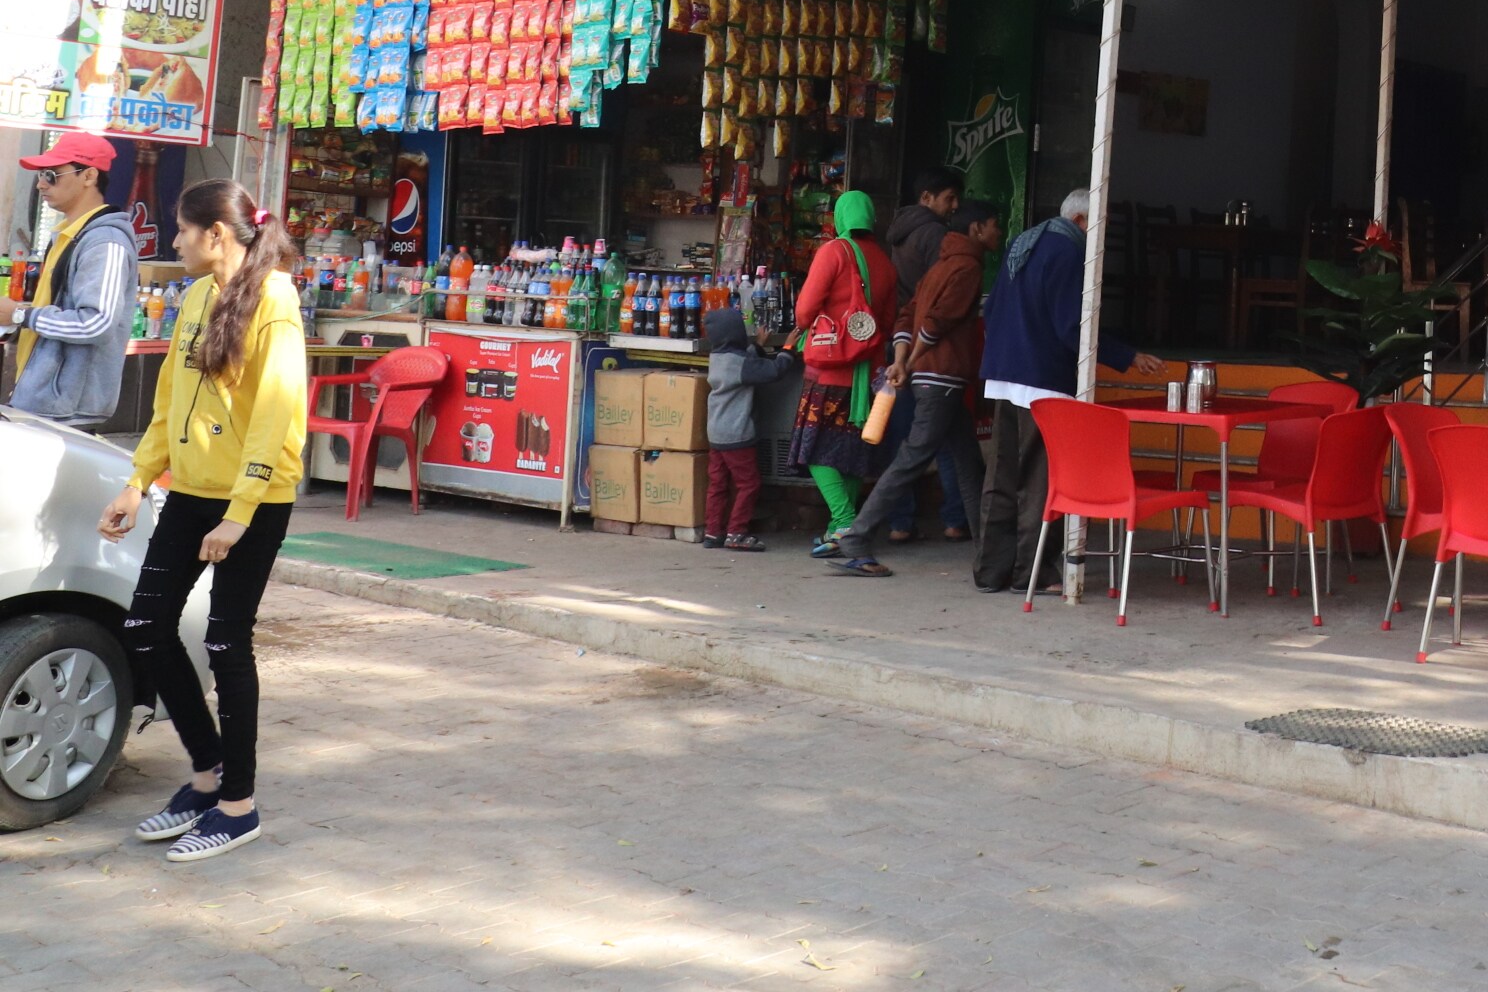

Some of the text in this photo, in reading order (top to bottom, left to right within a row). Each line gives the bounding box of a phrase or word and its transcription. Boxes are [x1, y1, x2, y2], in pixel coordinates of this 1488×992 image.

[952, 104, 1014, 163] Sprite
[531, 347, 562, 373] Vadilal
[647, 405, 684, 428] Bailley
[248, 464, 272, 480] SOME
[645, 482, 684, 504] Bailley
